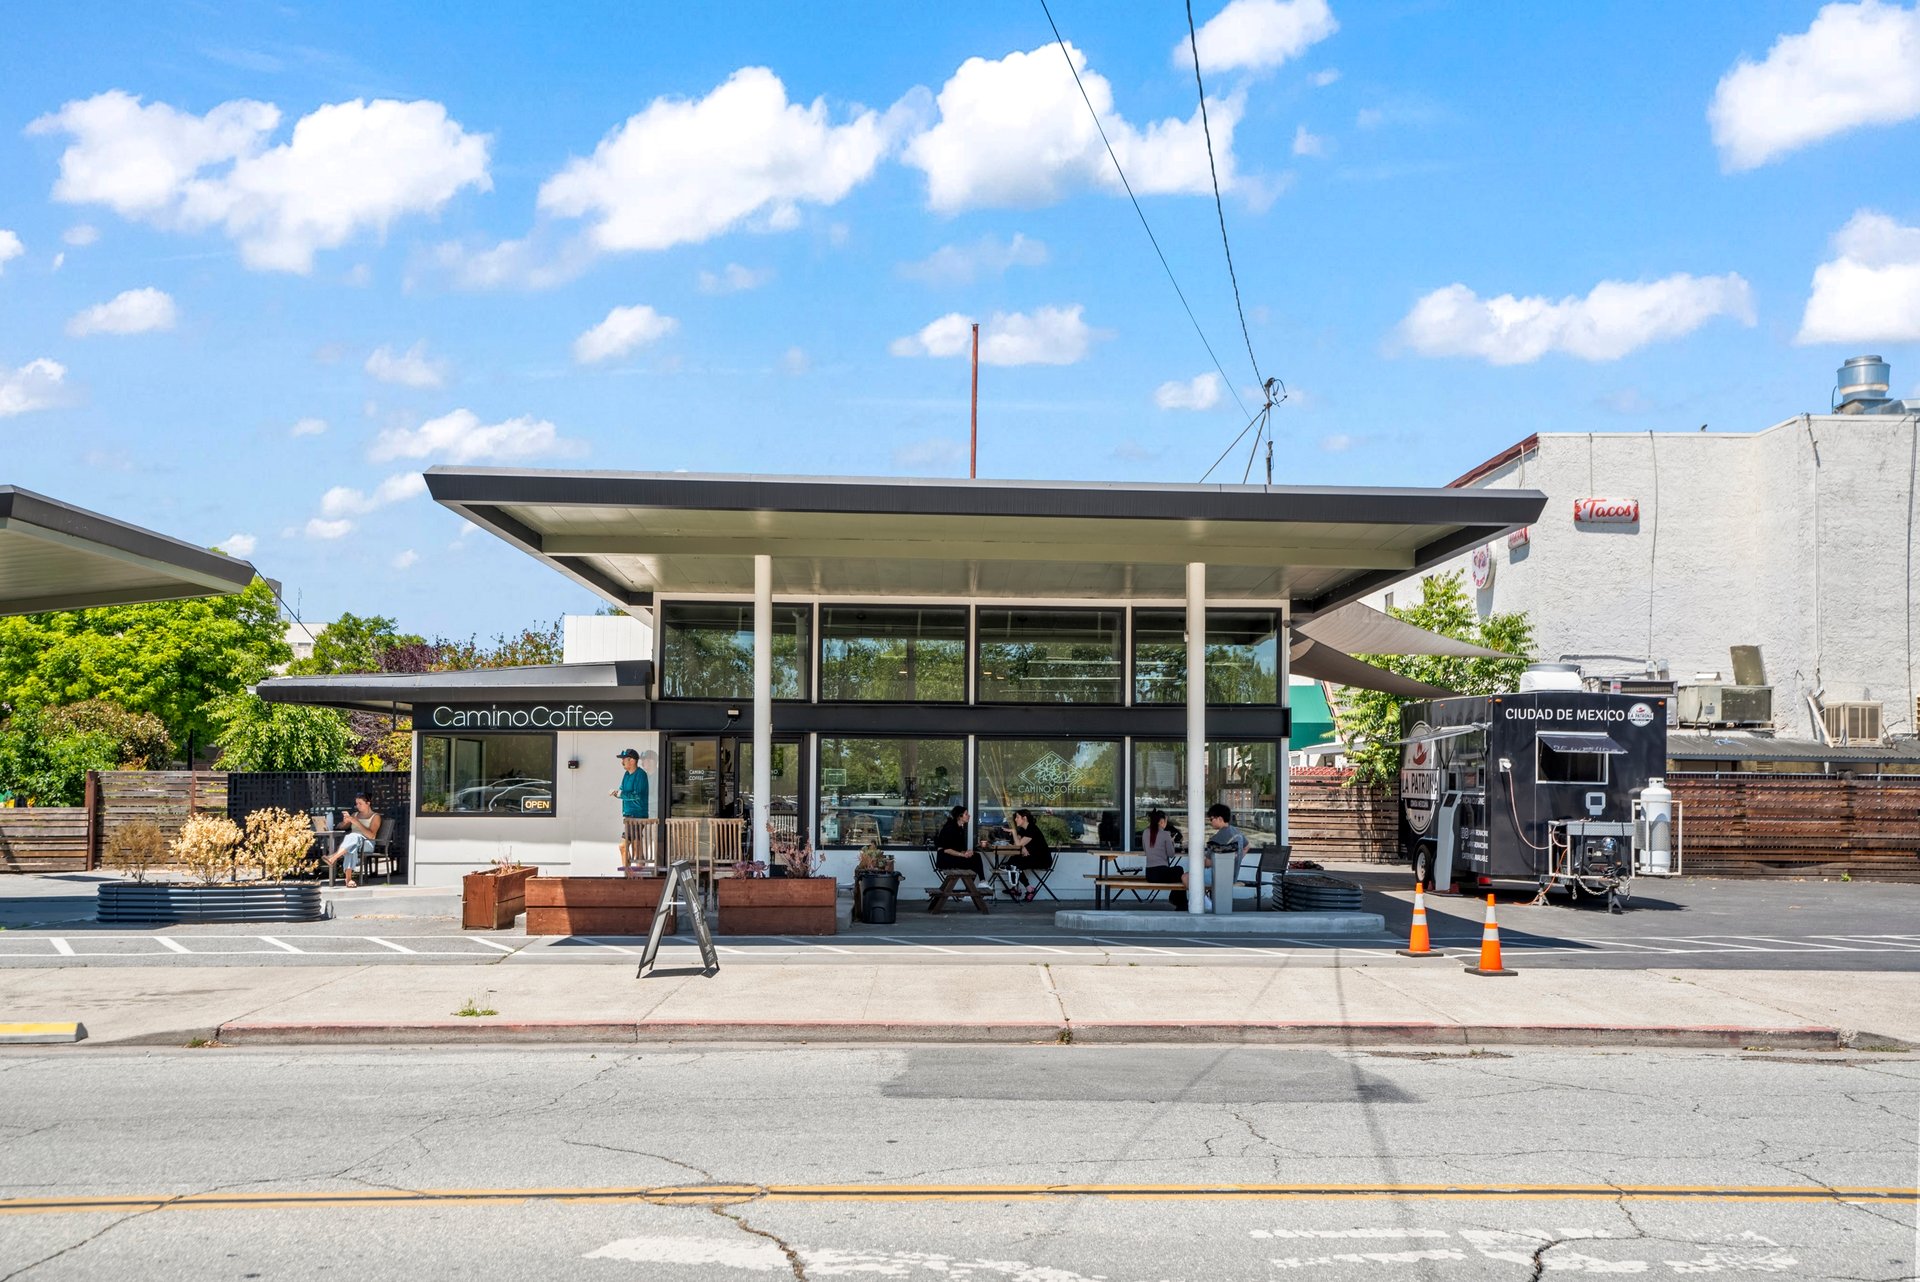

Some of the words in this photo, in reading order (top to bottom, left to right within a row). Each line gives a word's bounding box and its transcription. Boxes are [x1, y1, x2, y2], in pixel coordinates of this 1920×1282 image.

[1584, 498, 1631, 519] Tacos
[433, 704, 613, 727] CaminoCoffee
[1505, 708, 1553, 720] CIUDAD
[1556, 709, 1573, 720] DE
[1576, 709, 1625, 721] MEXICO
[1018, 785, 1050, 794] CAMINO
[1053, 785, 1086, 794] COFFEE
[1402, 773, 1409, 794] LA
[1411, 773, 1438, 795] PATRONA
[525, 800, 549, 809] OPEN
